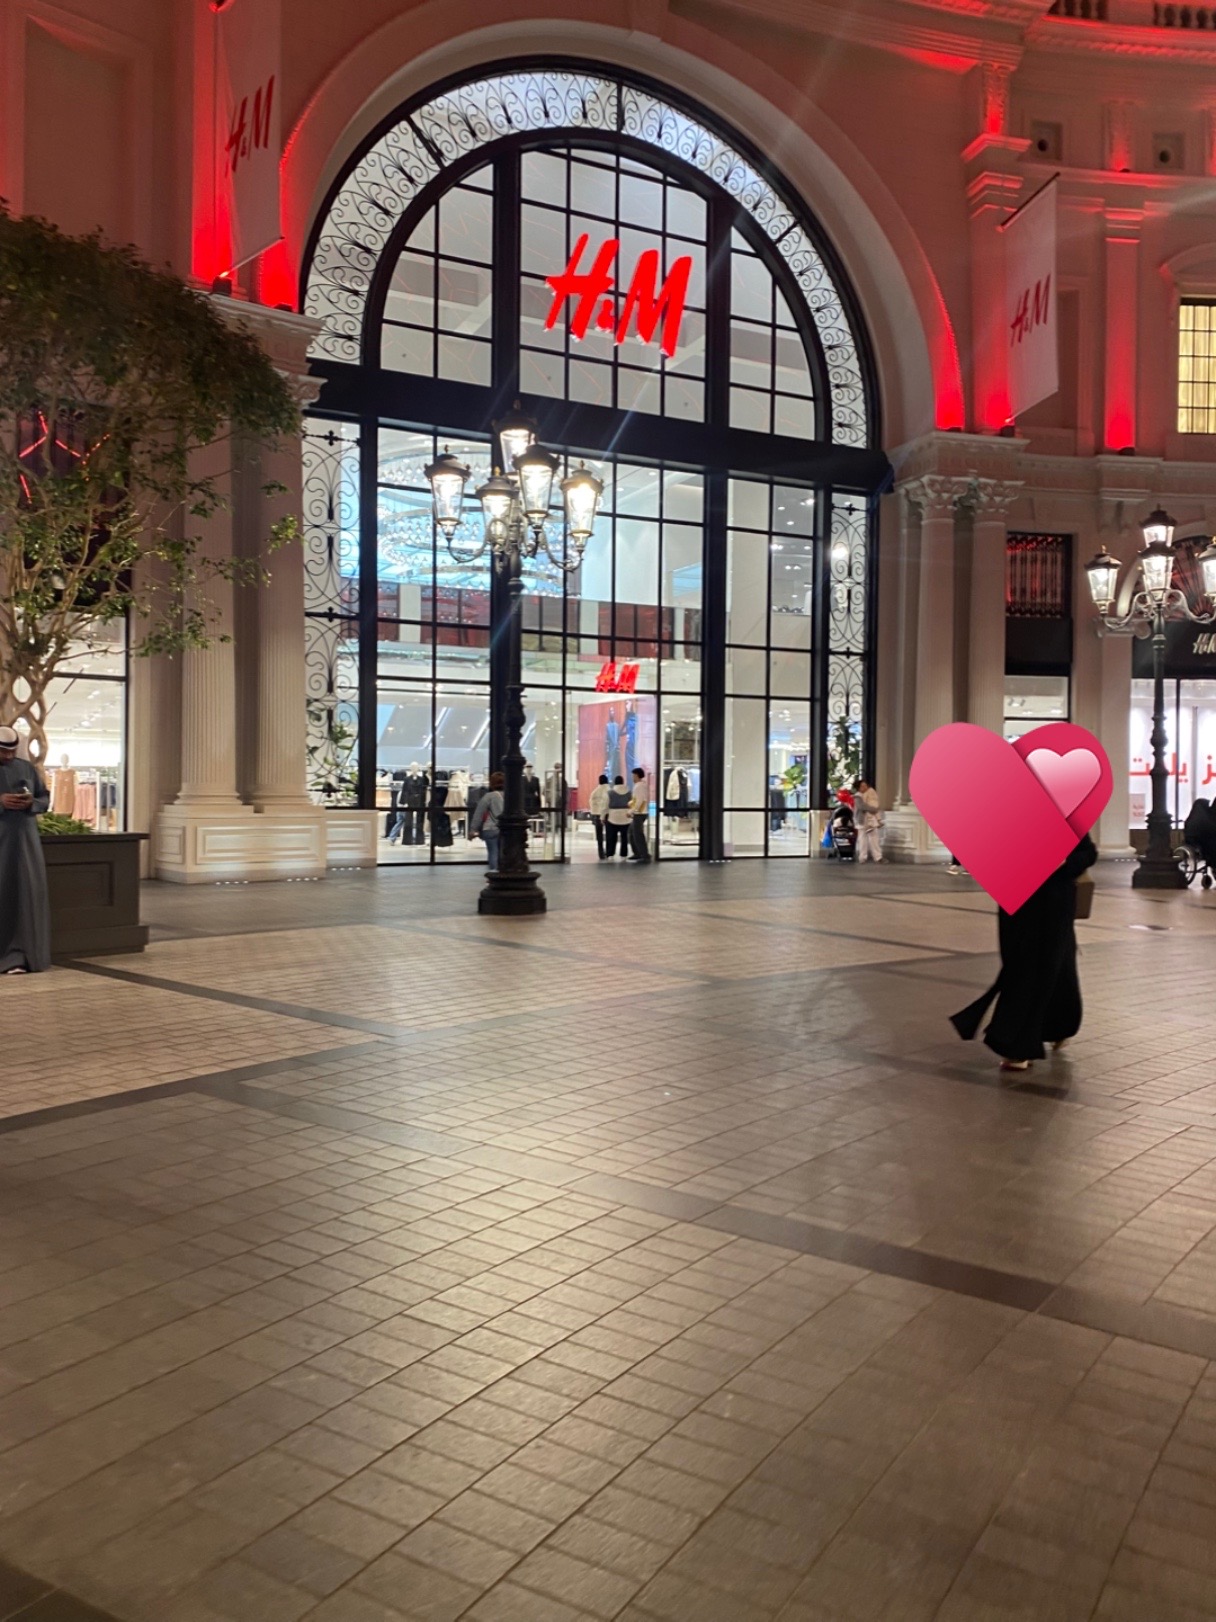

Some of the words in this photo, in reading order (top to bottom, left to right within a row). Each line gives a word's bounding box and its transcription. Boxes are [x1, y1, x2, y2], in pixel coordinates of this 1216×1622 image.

[224, 75, 275, 178] H&M
[544, 233, 692, 358] H&M
[1010, 274, 1051, 347] H&M
